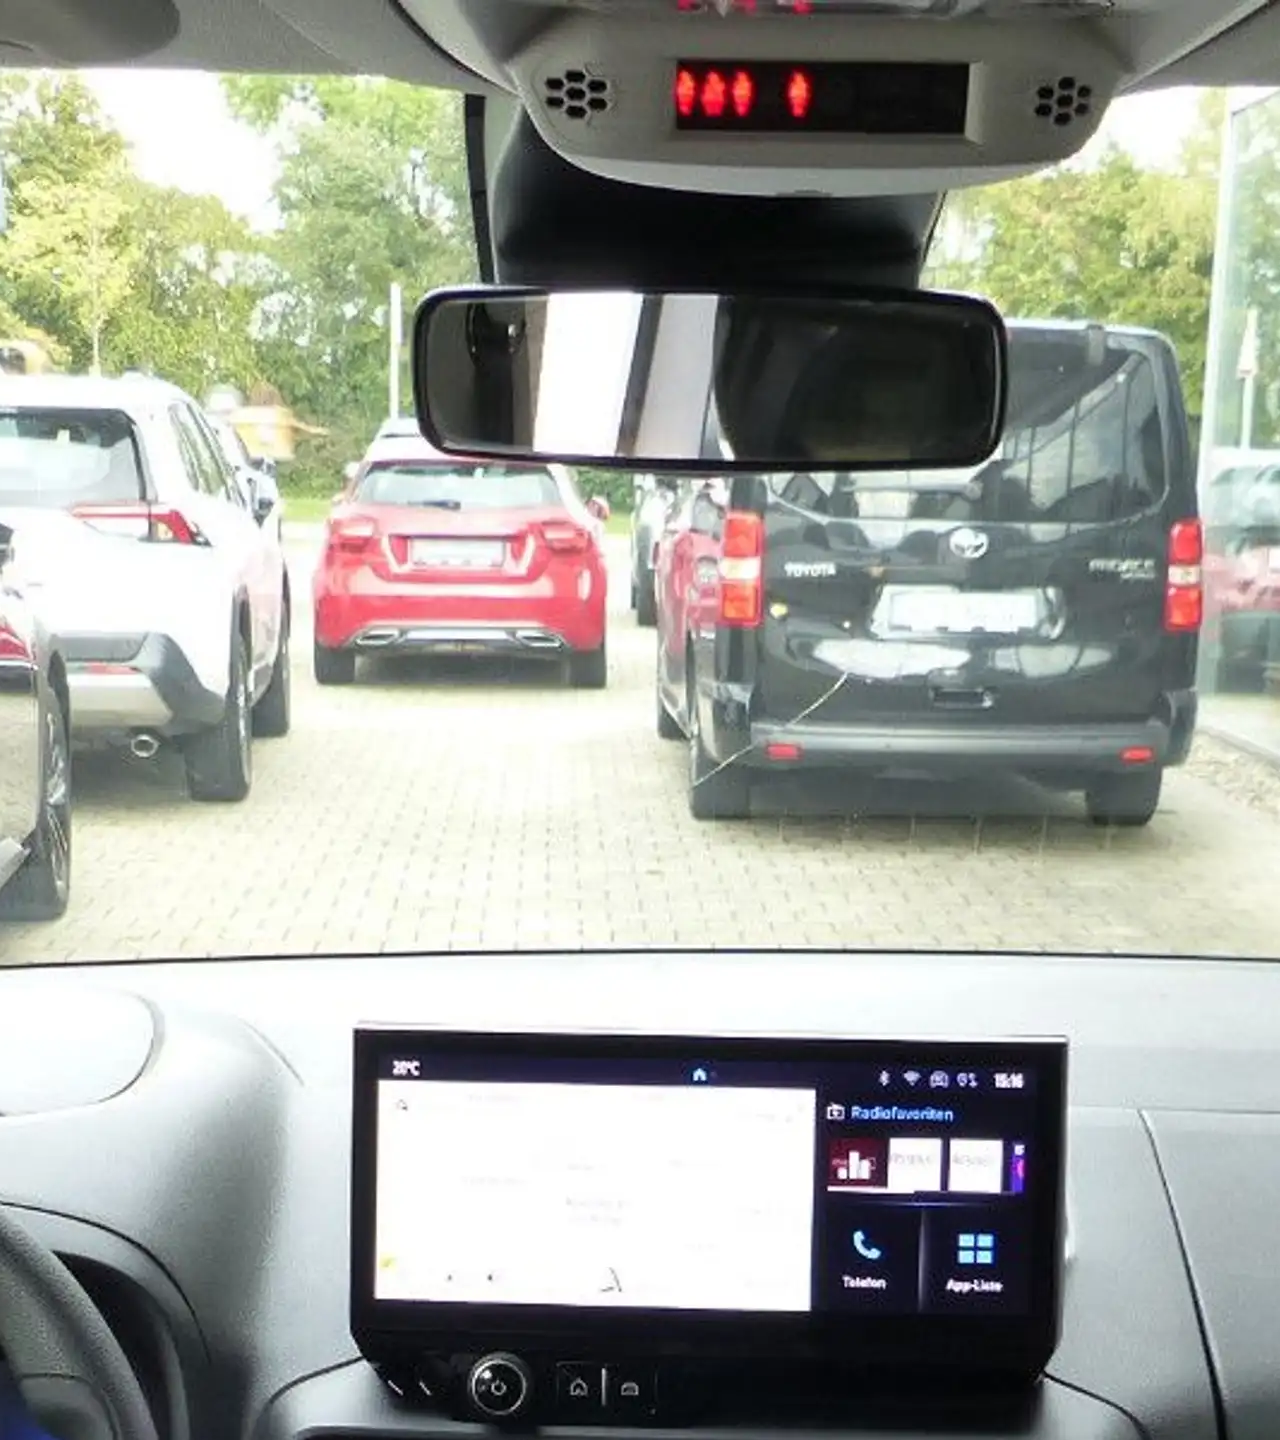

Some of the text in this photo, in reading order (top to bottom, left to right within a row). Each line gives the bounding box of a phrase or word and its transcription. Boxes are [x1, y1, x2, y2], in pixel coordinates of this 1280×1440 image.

[784, 562, 837, 577] TOYOTA
[851, 1106, 954, 1122] Radiofavoriten
[842, 1275, 887, 1290] Telefon
[946, 1279, 1003, 1292] App-Liste
